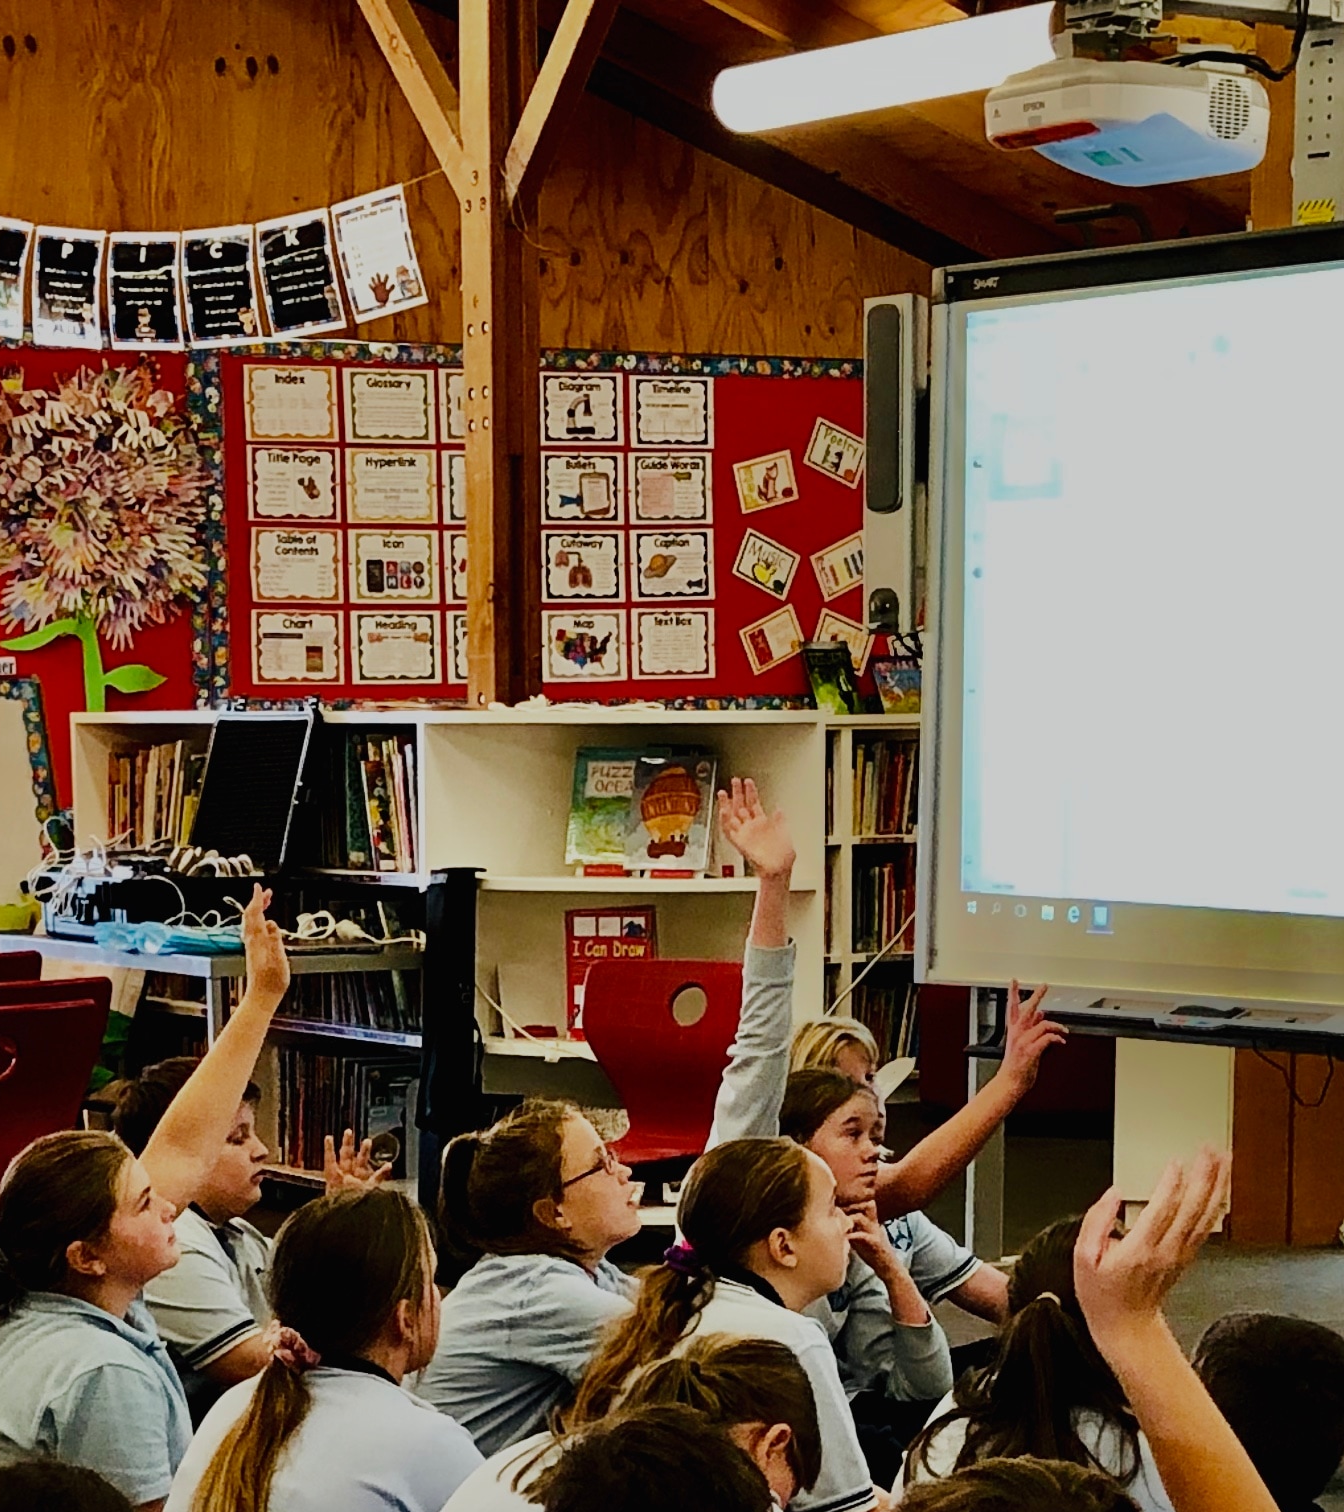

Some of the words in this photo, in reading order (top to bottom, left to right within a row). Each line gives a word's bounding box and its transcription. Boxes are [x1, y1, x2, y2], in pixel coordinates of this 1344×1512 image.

[284, 229, 300, 247] K
[61, 243, 74, 259] P
[209, 242, 223, 259] C
[274, 373, 306, 386] Index
[366, 377, 411, 391] Glossary
[558, 381, 601, 394] Diagram
[652, 384, 691, 395] Timeline
[267, 453, 290, 464] Title
[293, 453, 321, 466] Page
[365, 456, 416, 470] Hyperlink
[565, 460, 597, 471] Bullets
[640, 459, 667, 470] Guide
[669, 460, 700, 470] Words
[276, 534, 304, 545] Table
[306, 534, 317, 545] of
[382, 538, 405, 550] Icon
[560, 539, 603, 551] Cutaway
[654, 537, 689, 549] Caption
[274, 546, 319, 557] Contents
[282, 618, 313, 630] Chart
[375, 620, 417, 632] Heading
[573, 619, 595, 632] Map
[654, 616, 673, 627] Text
[675, 616, 692, 627] Box
[595, 780, 633, 793] OCEA
[572, 940, 580, 957] I
[584, 940, 608, 957] Can
[613, 940, 646, 957] Draw
